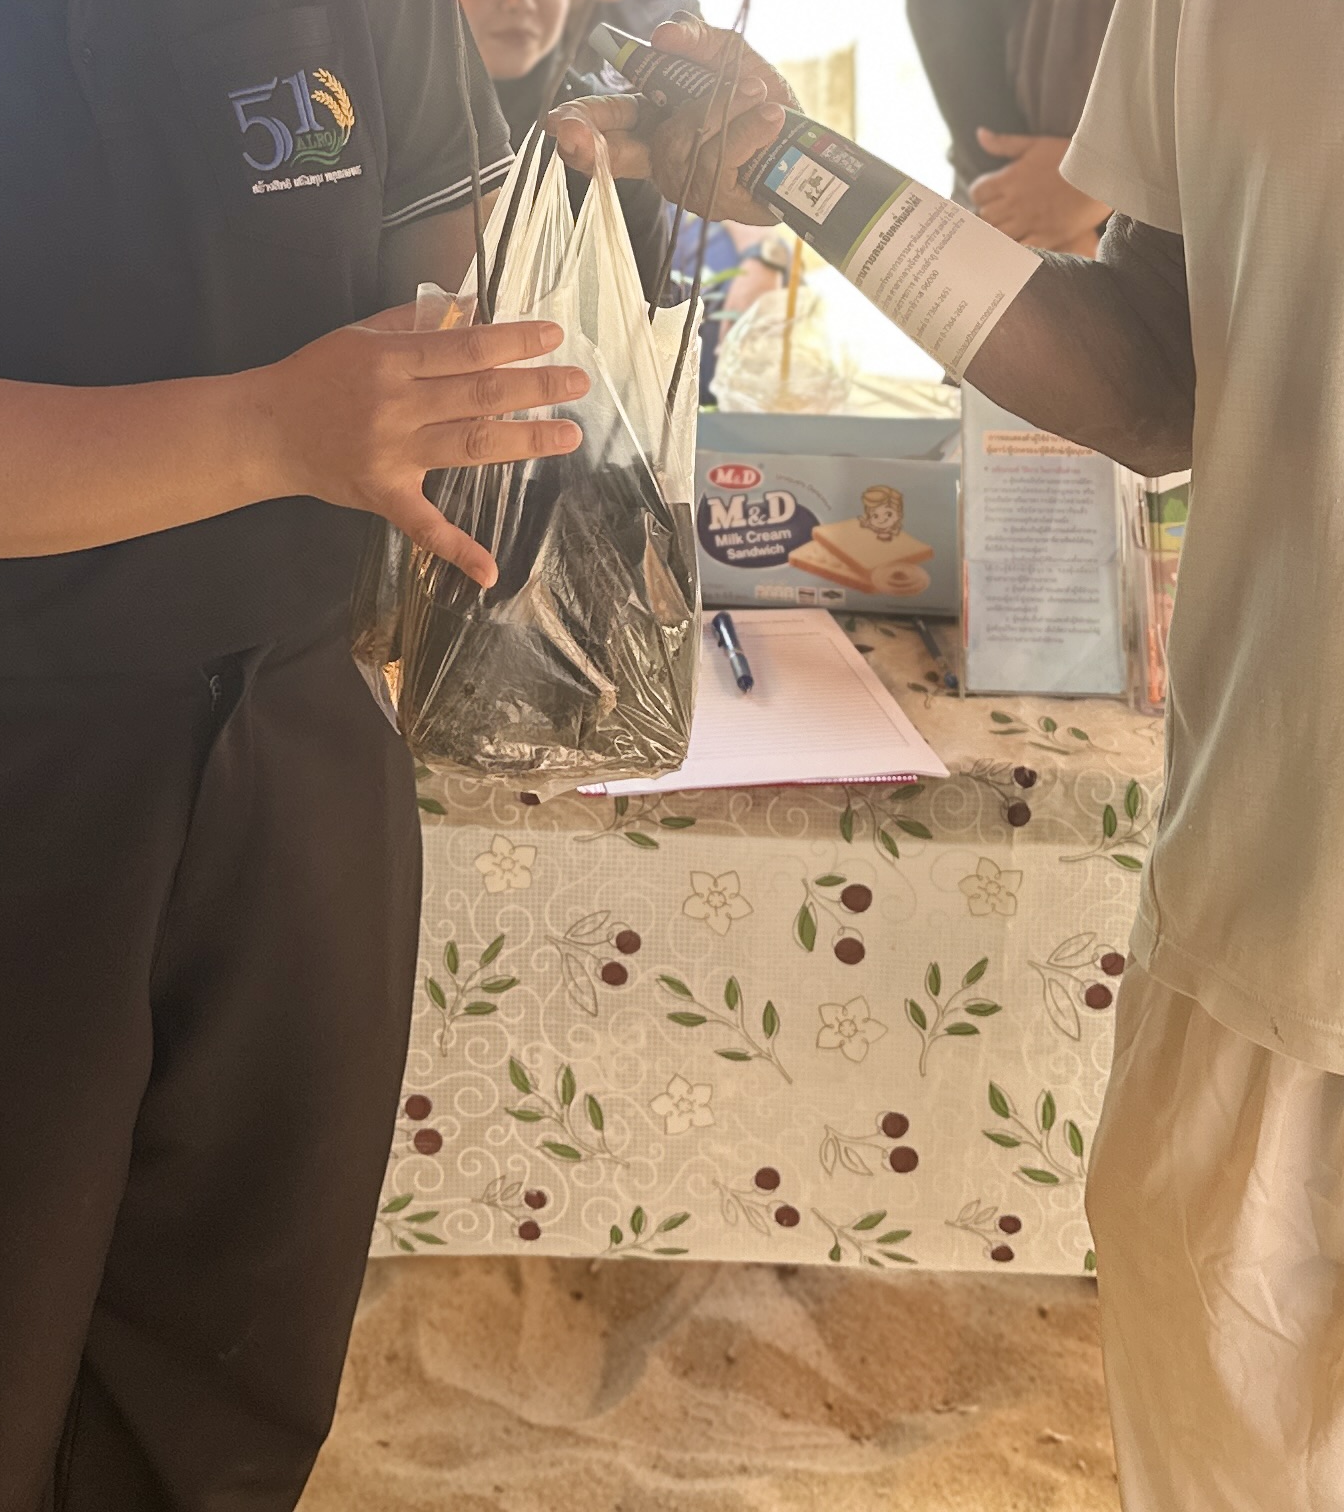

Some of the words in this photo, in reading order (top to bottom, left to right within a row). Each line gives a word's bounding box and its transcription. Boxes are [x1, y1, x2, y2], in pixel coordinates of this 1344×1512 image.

[228, 69, 325, 172] 51
[715, 468, 757, 486] M&D
[707, 491, 797, 531] M&D
[714, 532, 744, 548] Milk
[746, 529, 792, 544] Cream
[726, 544, 785, 561] Sandwich
